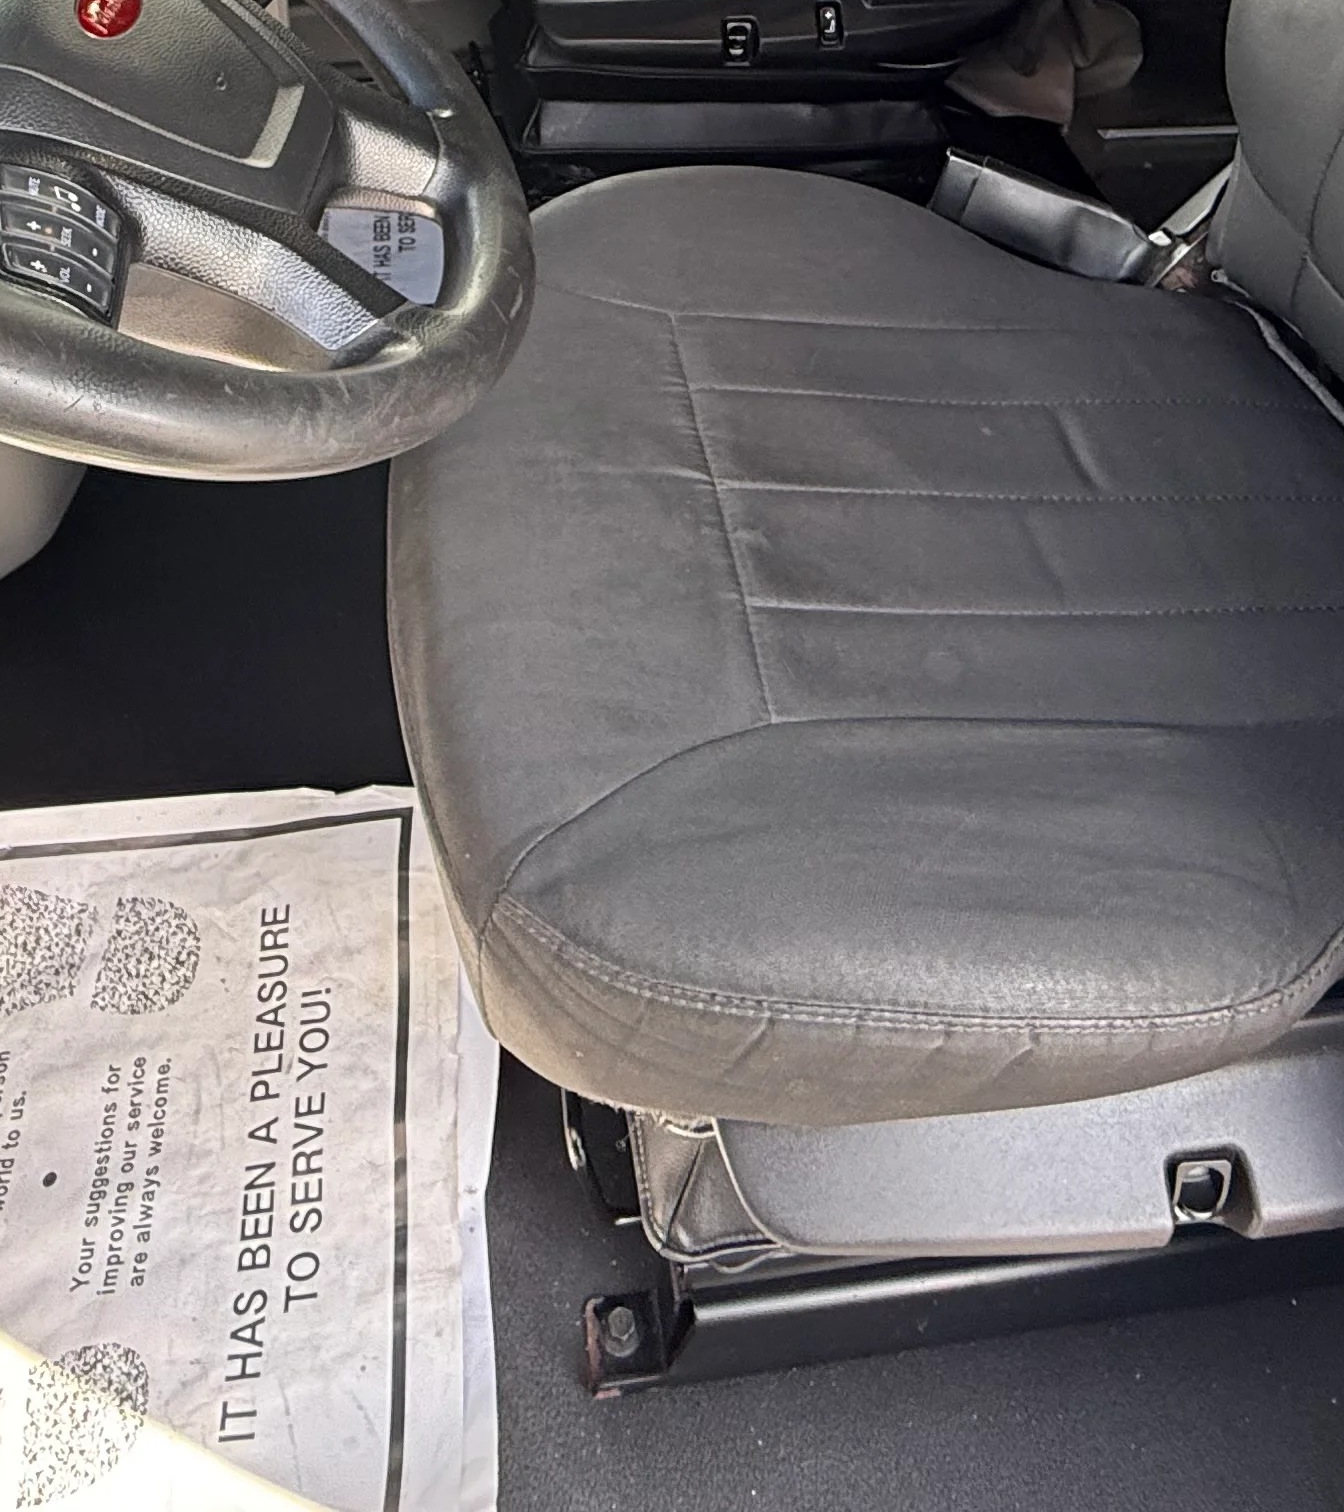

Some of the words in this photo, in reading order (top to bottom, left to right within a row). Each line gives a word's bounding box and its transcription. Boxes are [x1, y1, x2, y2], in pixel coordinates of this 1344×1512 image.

[373, 215, 392, 242] BEEN
[373, 245, 392, 268] HAS
[398, 236, 417, 253] TO
[249, 903, 291, 1103] PLEASURE
[296, 987, 332, 1082] YOU!
[10, 1090, 27, 1121] us.
[126, 1056, 147, 1132] service
[146, 1057, 172, 1158] welcome.
[1, 1129, 21, 1150] to
[120, 1140, 138, 1174] our
[247, 1115, 280, 1145] A
[288, 1091, 326, 1234] SERVE
[69, 1237, 96, 1293] Your
[84, 1101, 118, 1228] suggestions
[101, 1064, 122, 1094] for
[132, 1165, 161, 1243] always
[96, 1181, 135, 1296] improving
[237, 1161, 277, 1273] BEEN
[130, 1251, 149, 1287] are
[283, 1251, 321, 1314] TO
[224, 1288, 268, 1382] HAS
[218, 1400, 258, 1444] IT
